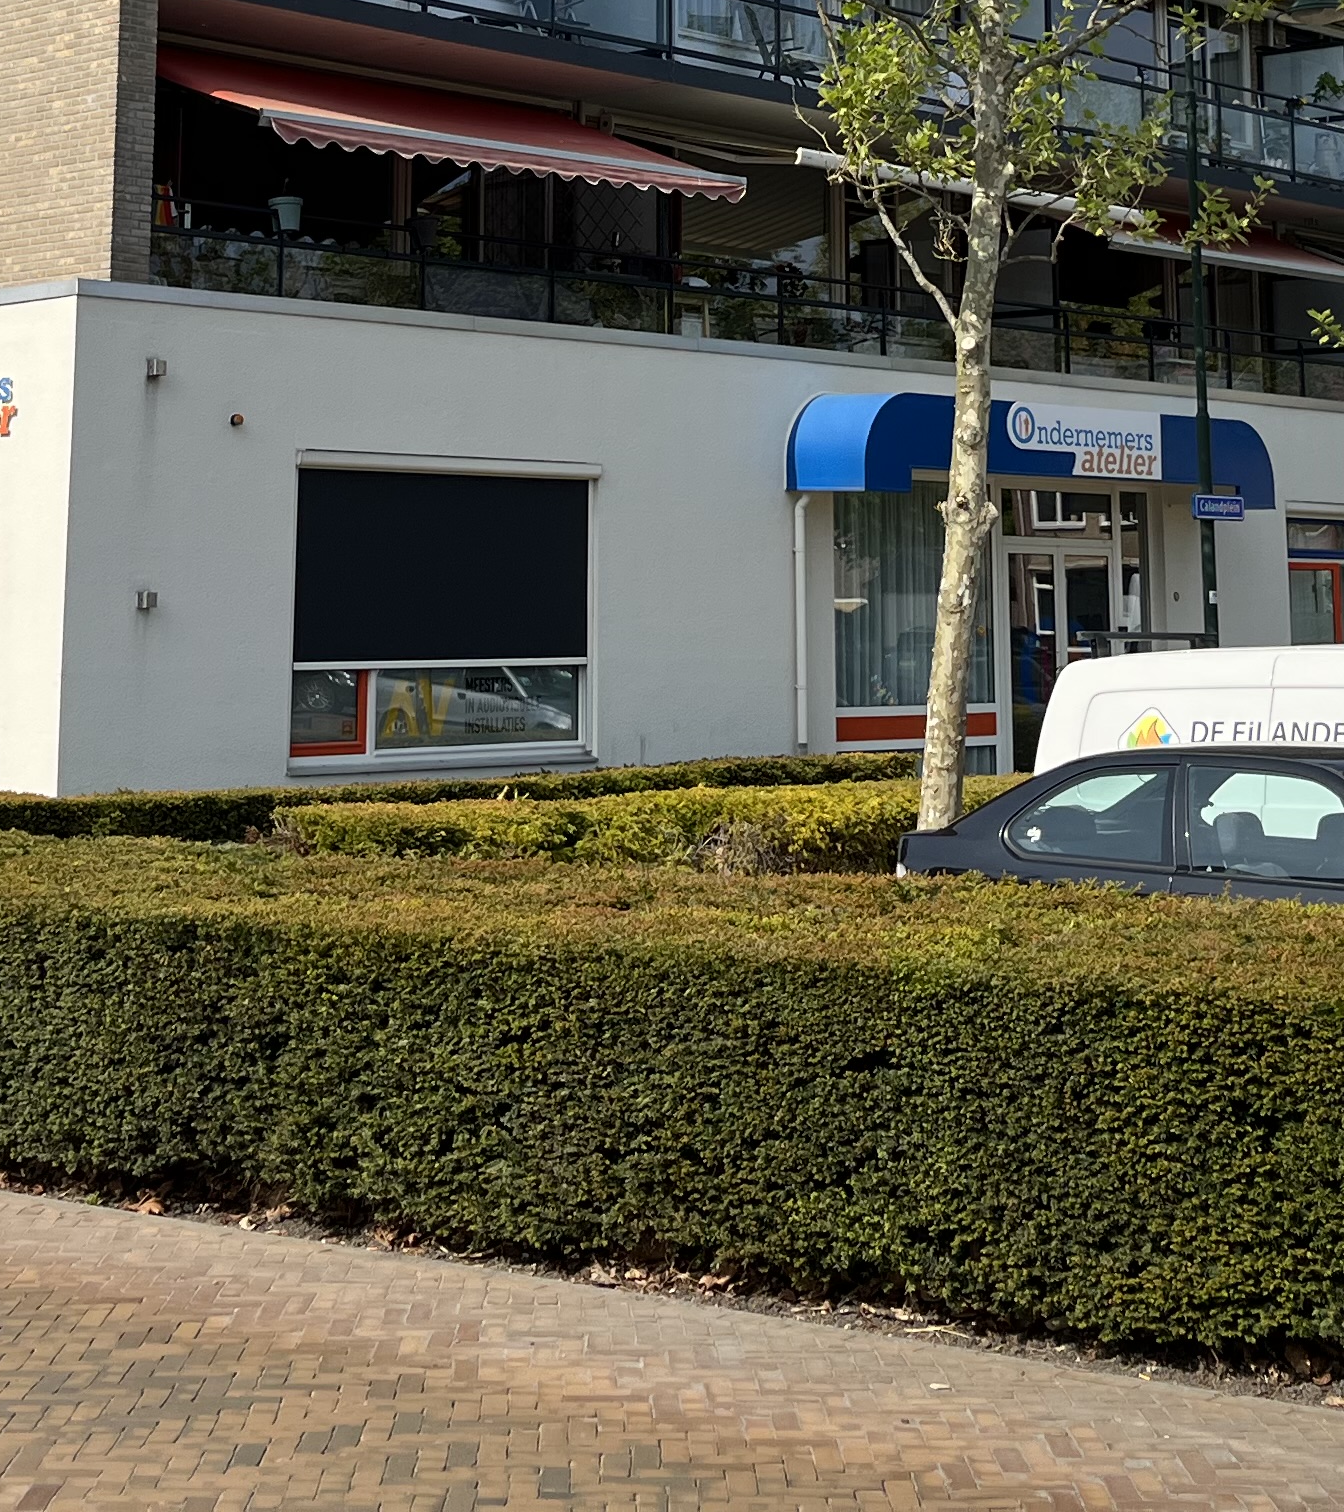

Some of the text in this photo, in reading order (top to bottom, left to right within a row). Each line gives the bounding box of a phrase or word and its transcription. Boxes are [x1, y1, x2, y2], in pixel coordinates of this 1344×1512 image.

[1012, 406, 1153, 452] Ondernemers
[1081, 444, 1157, 476] atelier
[1199, 499, 1240, 516] Calandplein
[465, 676, 513, 692] MEESTERS
[465, 697, 475, 713] IN
[465, 716, 526, 733] INSTALLATIES
[1191, 721, 1224, 742] DE
